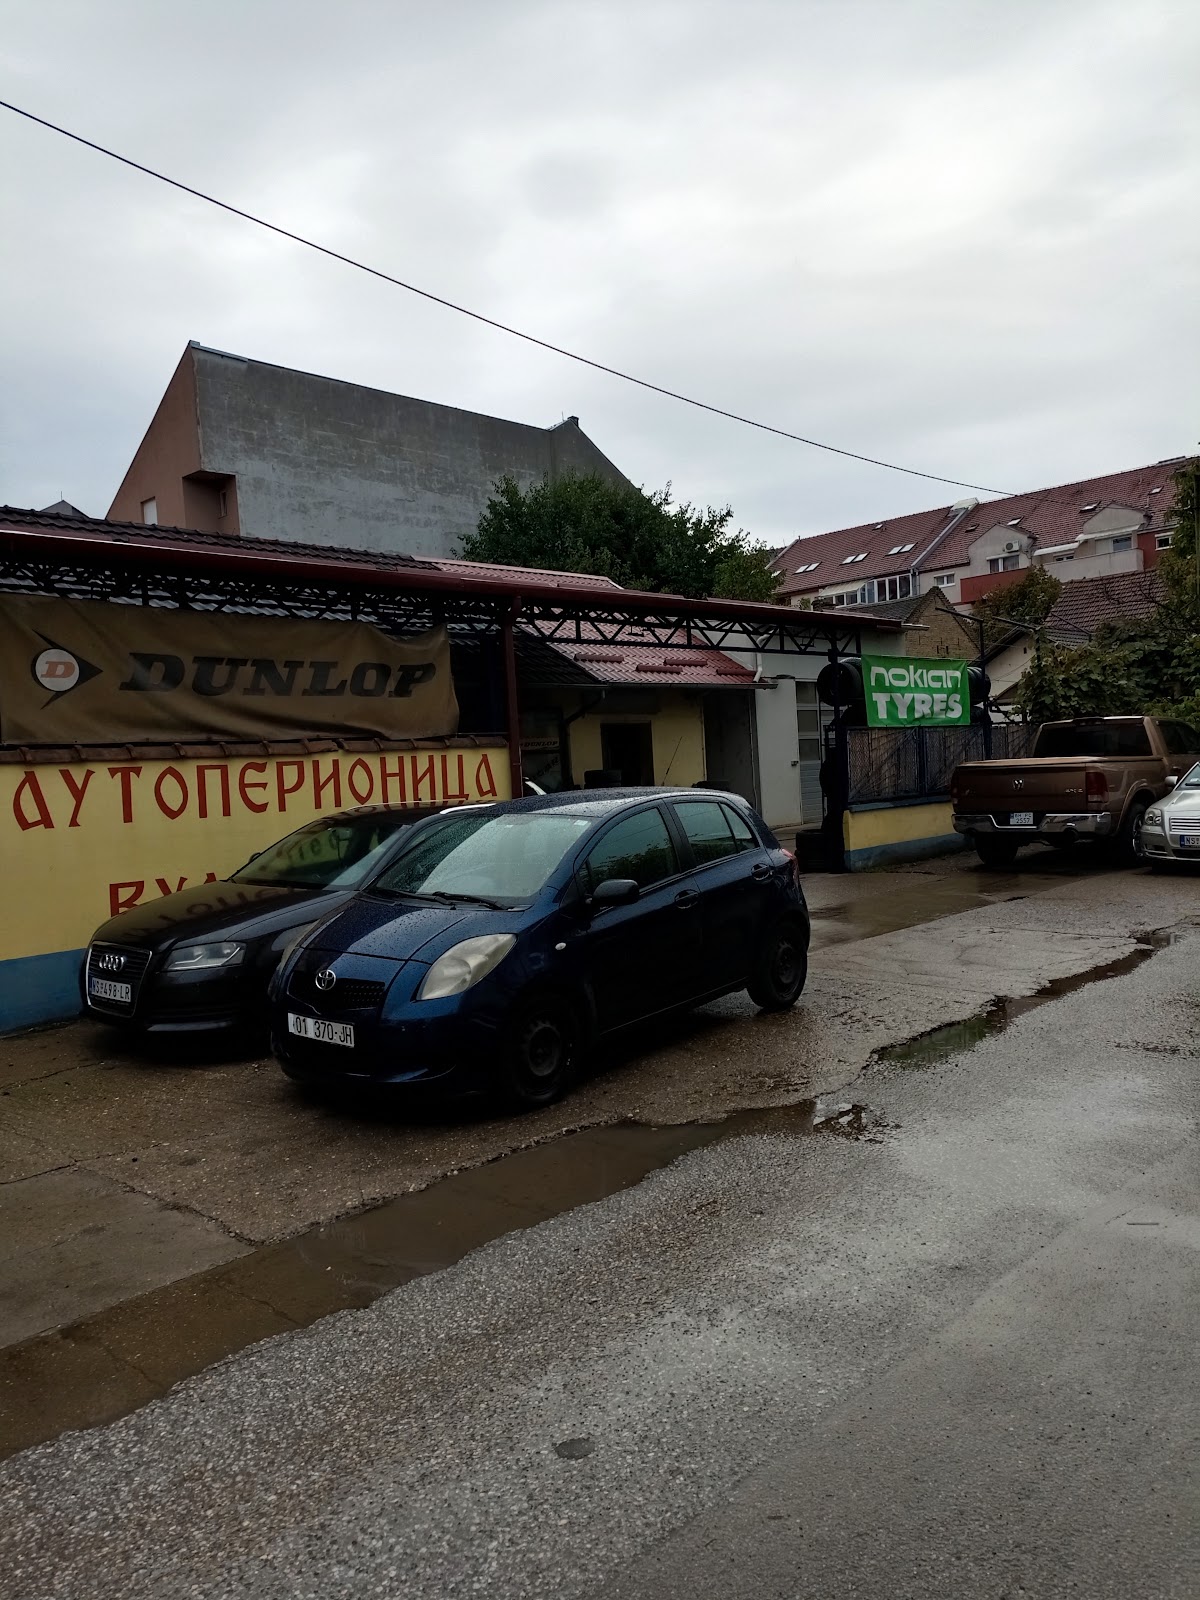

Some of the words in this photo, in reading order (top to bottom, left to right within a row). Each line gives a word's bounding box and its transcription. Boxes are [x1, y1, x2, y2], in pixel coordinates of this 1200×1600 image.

[119, 652, 436, 698] DUNLOP
[871, 665, 961, 688] nokian
[872, 692, 962, 719] TYRES
